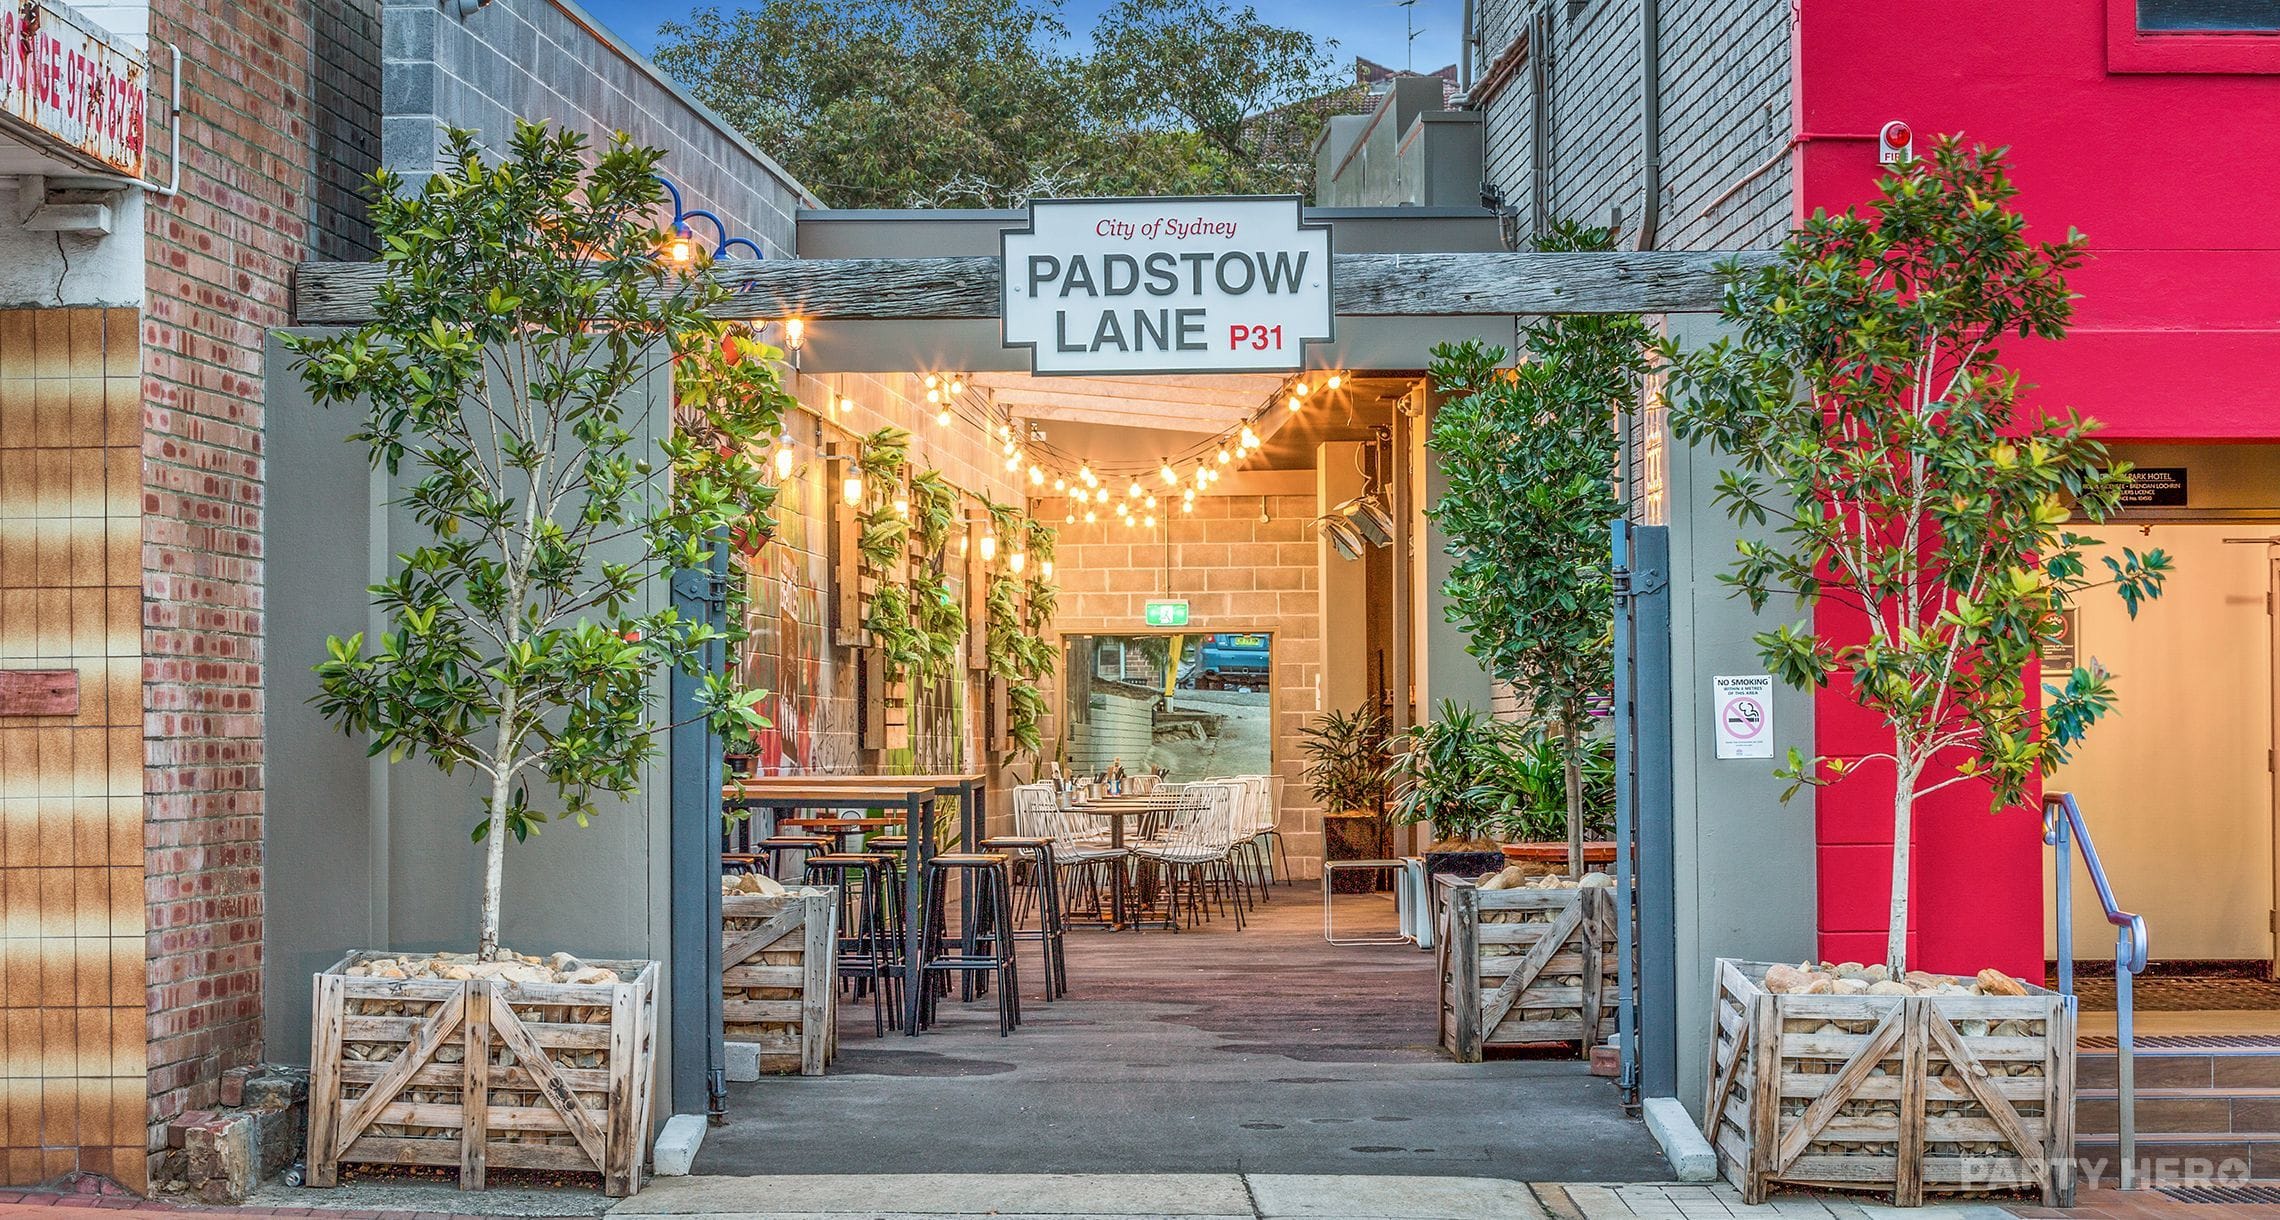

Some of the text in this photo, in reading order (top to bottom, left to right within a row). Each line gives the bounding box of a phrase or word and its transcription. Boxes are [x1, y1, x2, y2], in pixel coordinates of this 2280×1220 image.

[1095, 217, 1237, 240] City of Sydney
[1028, 250, 1309, 298] PADSTOW
[1056, 308, 1283, 353] LANE P31
[1731, 678, 1768, 686] SMOKING
